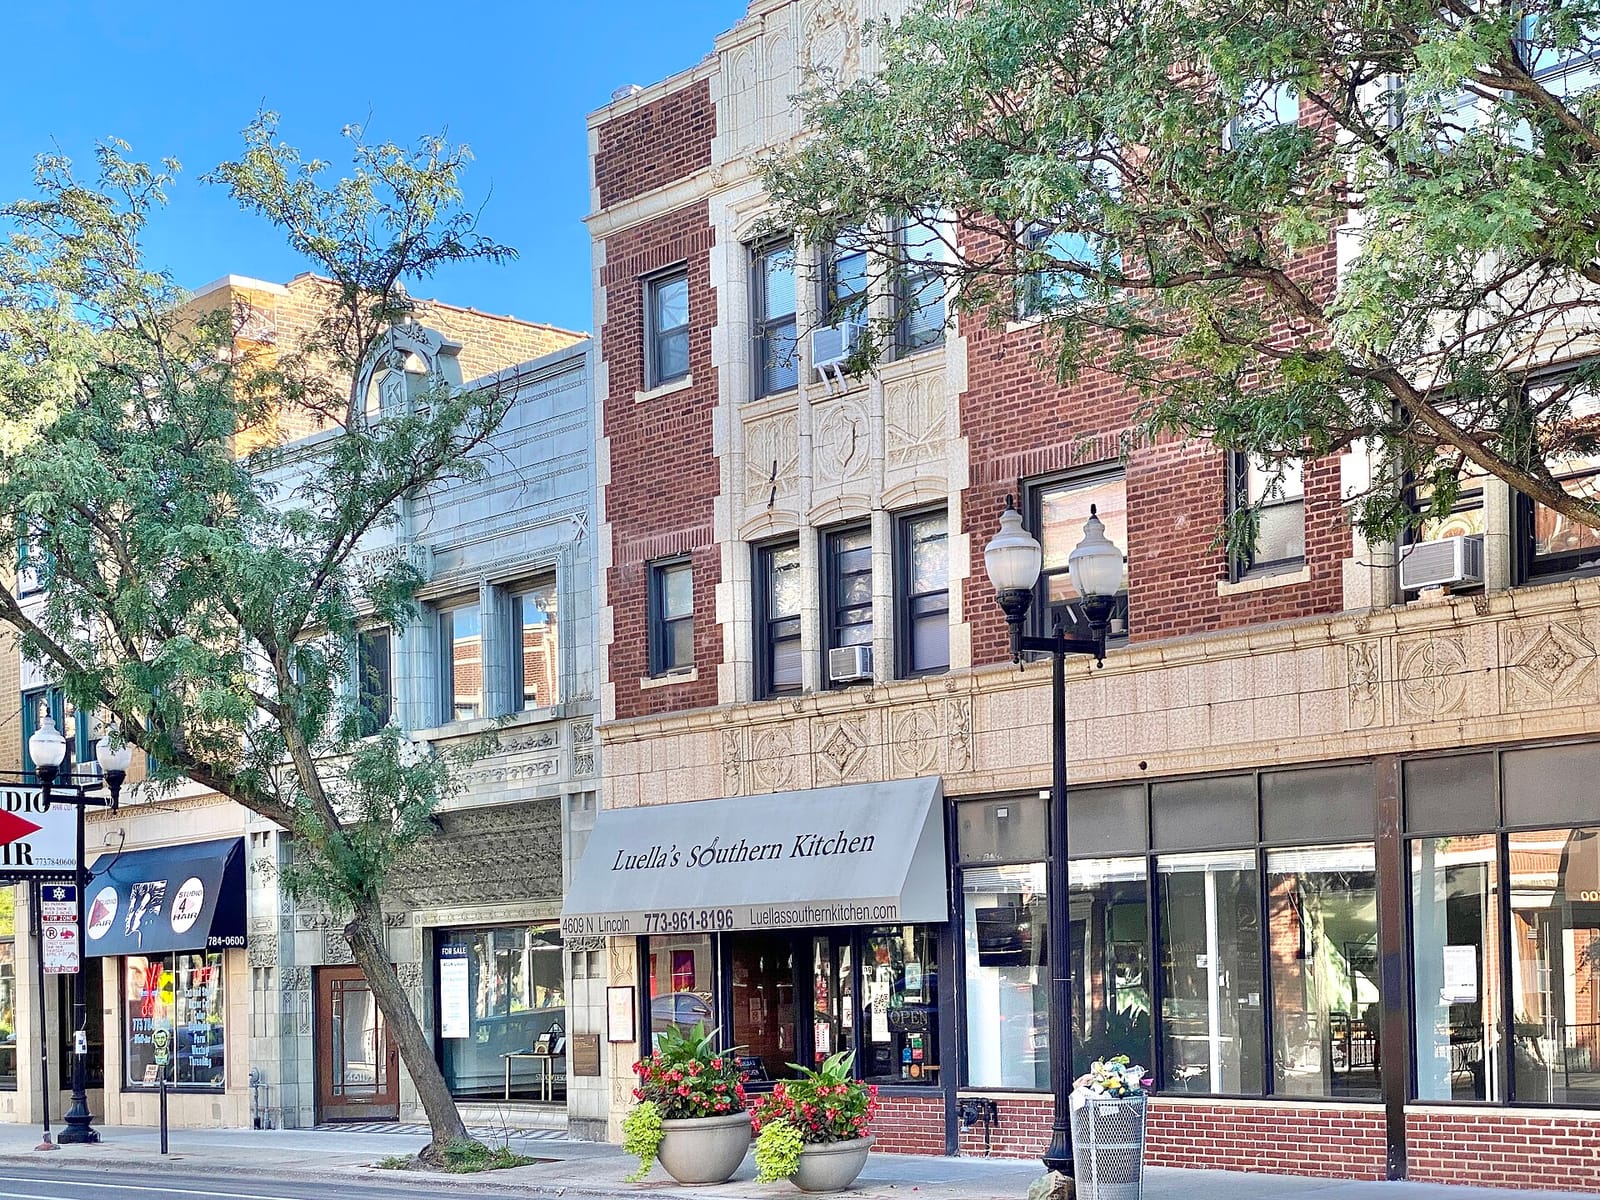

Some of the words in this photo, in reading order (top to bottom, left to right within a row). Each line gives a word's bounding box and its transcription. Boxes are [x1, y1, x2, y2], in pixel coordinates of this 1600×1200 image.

[0, 791, 51, 814] DIO
[611, 845, 681, 871] Luella's
[686, 836, 783, 868] Southern
[789, 830, 875, 858] Kitchen
[35, 858, 76, 866] 7737840600
[178, 890, 202, 899] STUDIO
[178, 897, 187, 913] 4
[173, 912, 198, 921] HAIR
[562, 917, 584, 933] 4609
[586, 917, 594, 932] N
[599, 916, 630, 932] Lincoln
[644, 909, 733, 932] 773-961-8196
[750, 903, 897, 925] Luellassouthernkitchen.com
[208, 936, 245, 946] 784-0600
[441, 947, 452, 955] FOR
[453, 946, 467, 954] SALE
[890, 1010, 928, 1025] OPEN
